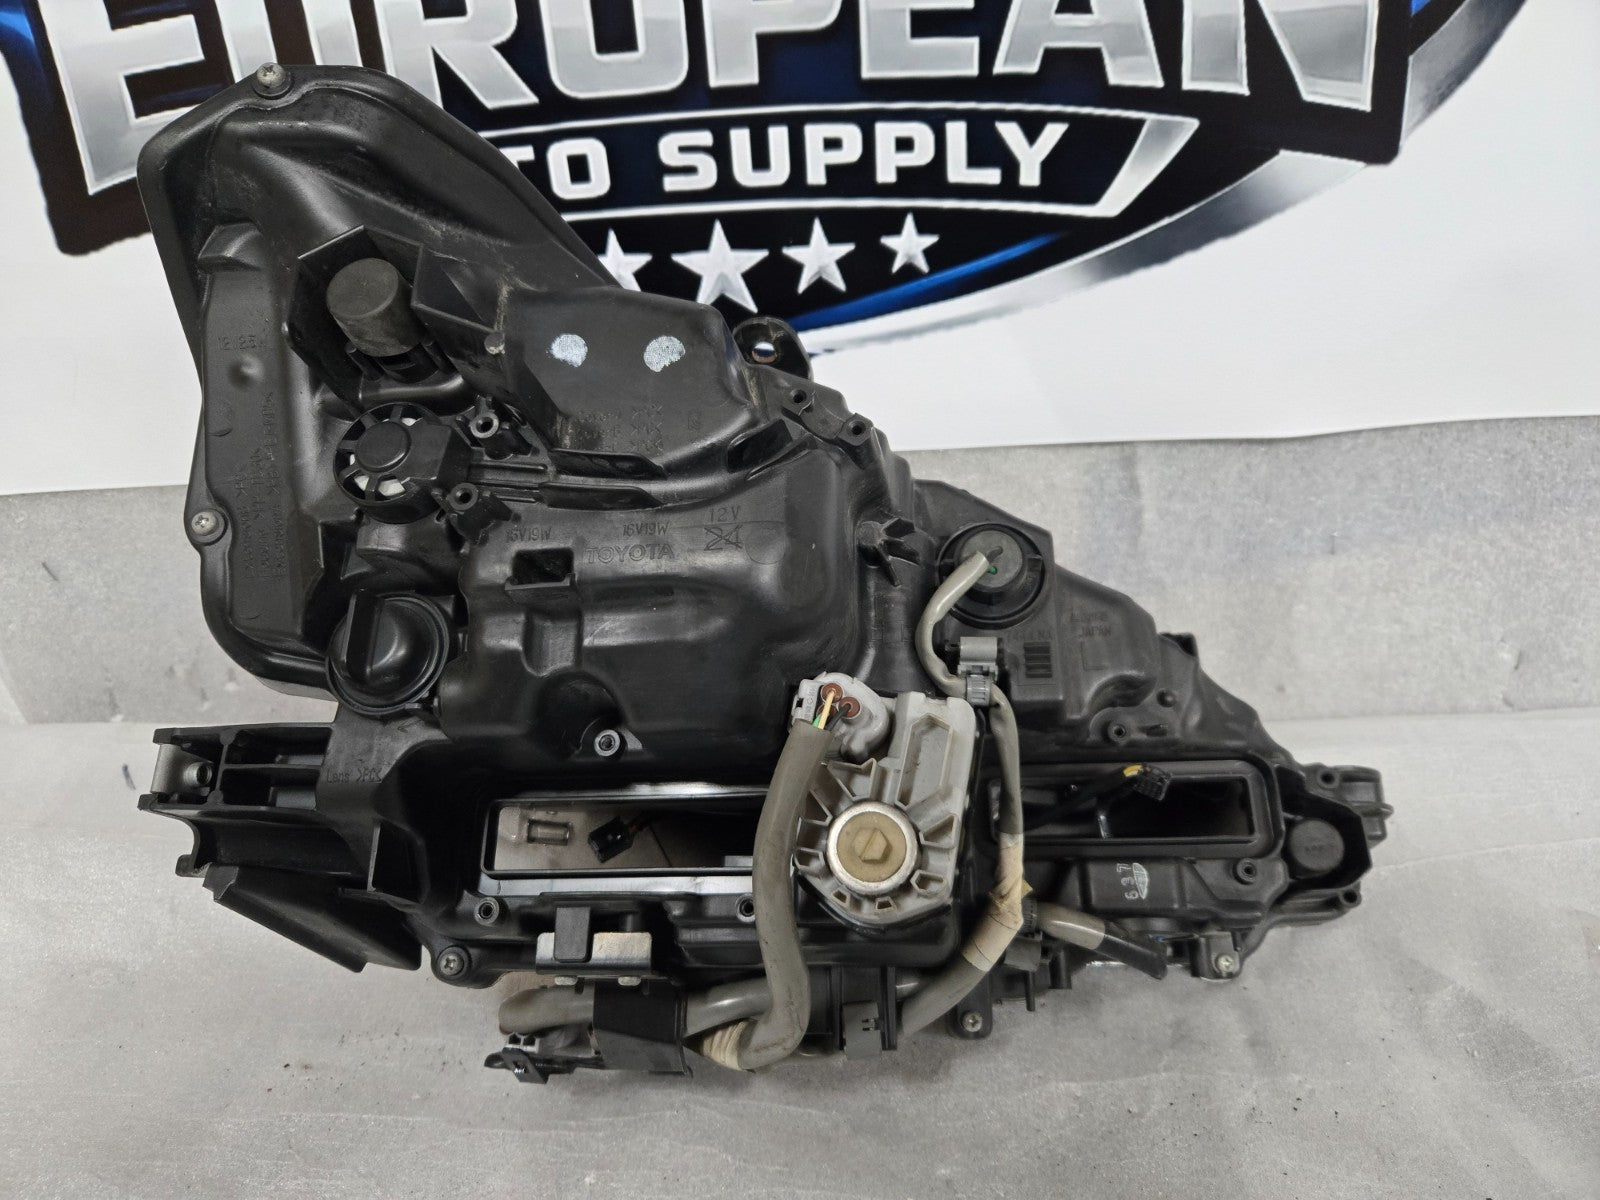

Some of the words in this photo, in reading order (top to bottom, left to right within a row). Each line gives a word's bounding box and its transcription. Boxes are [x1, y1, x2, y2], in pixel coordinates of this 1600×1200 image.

[660, 121, 1069, 192] SUPPLY
[710, 506, 741, 523] 12V
[585, 543, 675, 565] TOYOTA
